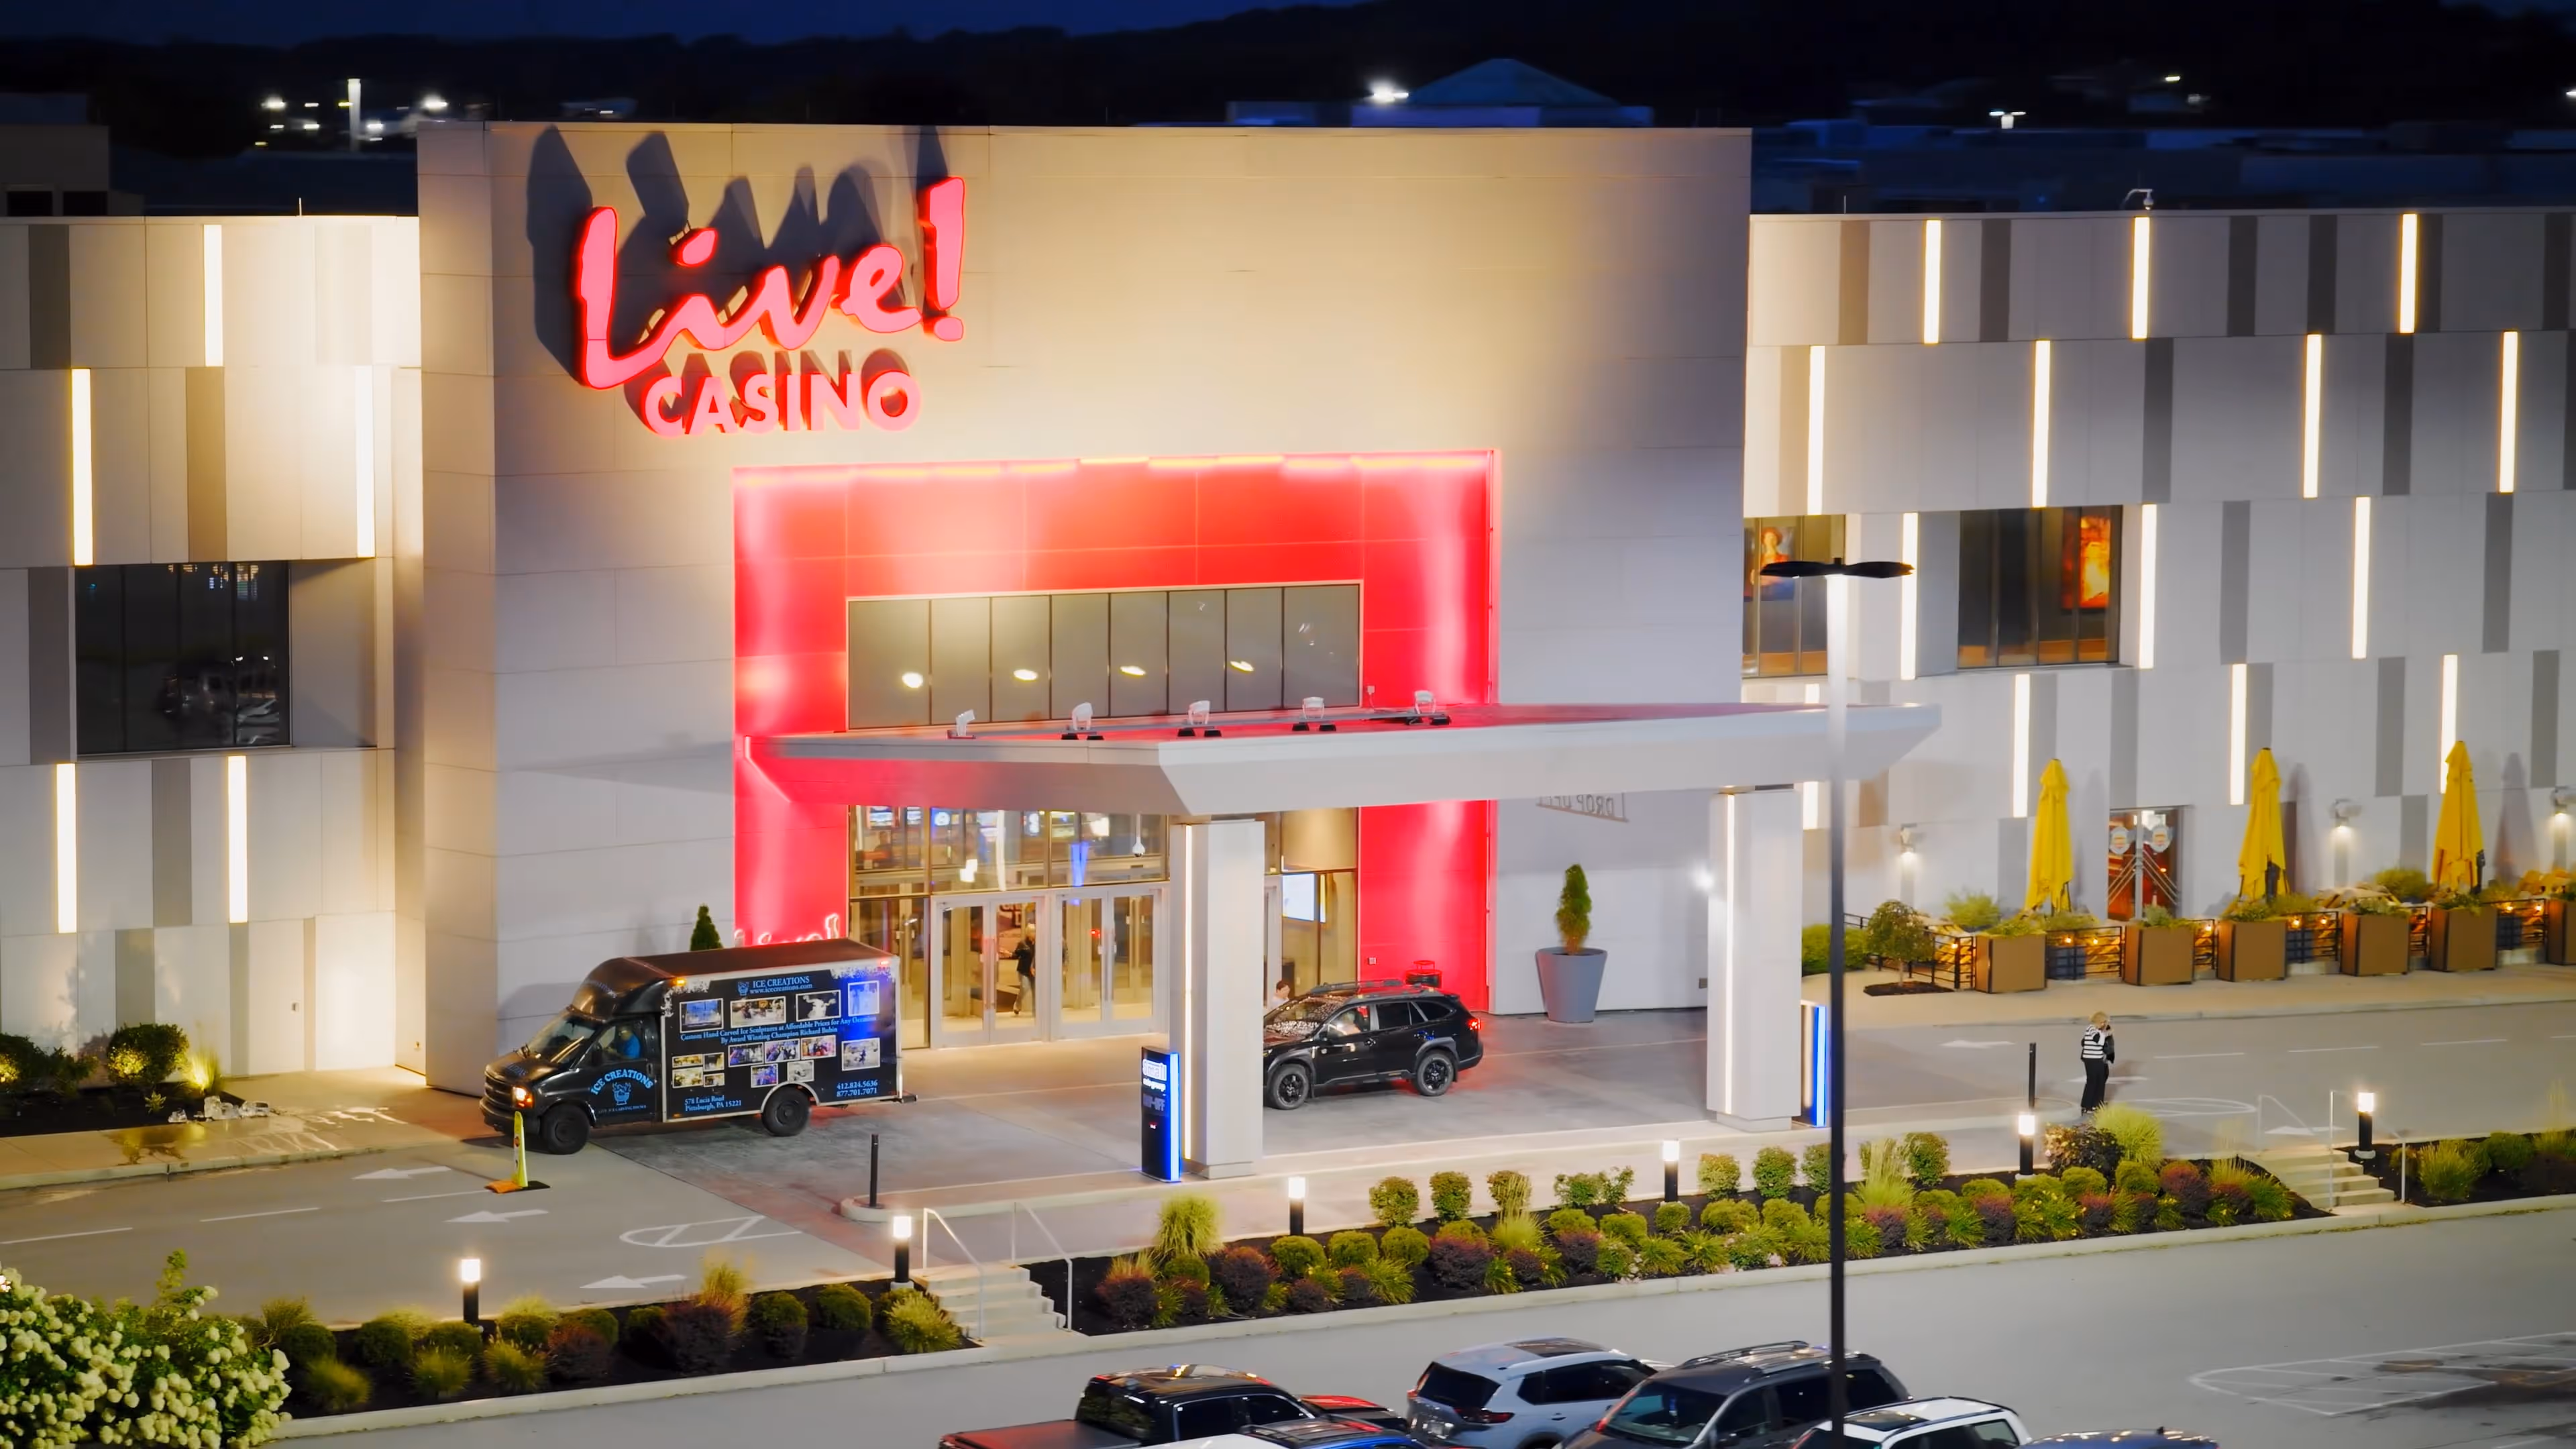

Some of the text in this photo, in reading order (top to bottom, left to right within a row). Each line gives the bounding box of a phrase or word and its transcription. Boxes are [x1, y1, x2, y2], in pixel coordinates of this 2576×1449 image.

[576, 176, 965, 390] Live!
[640, 370, 922, 438] CASINO
[749, 983, 813, 994] www.icecreations.com
[753, 976, 810, 988] ICE CREATIONS
[749, 1026, 777, 1036] Sculptures
[785, 1022, 814, 1030] Affordable
[840, 1017, 851, 1026] Any
[721, 1036, 728, 1044] By
[747, 1033, 770, 1042] Winning
[771, 1030, 799, 1038] Champion
[800, 1028, 820, 1036] Richard
[590, 1069, 654, 1095] ICE CREATIONS
[837, 1087, 877, 1097] 877.701.7071
[725, 1099, 741, 1108] 15221
